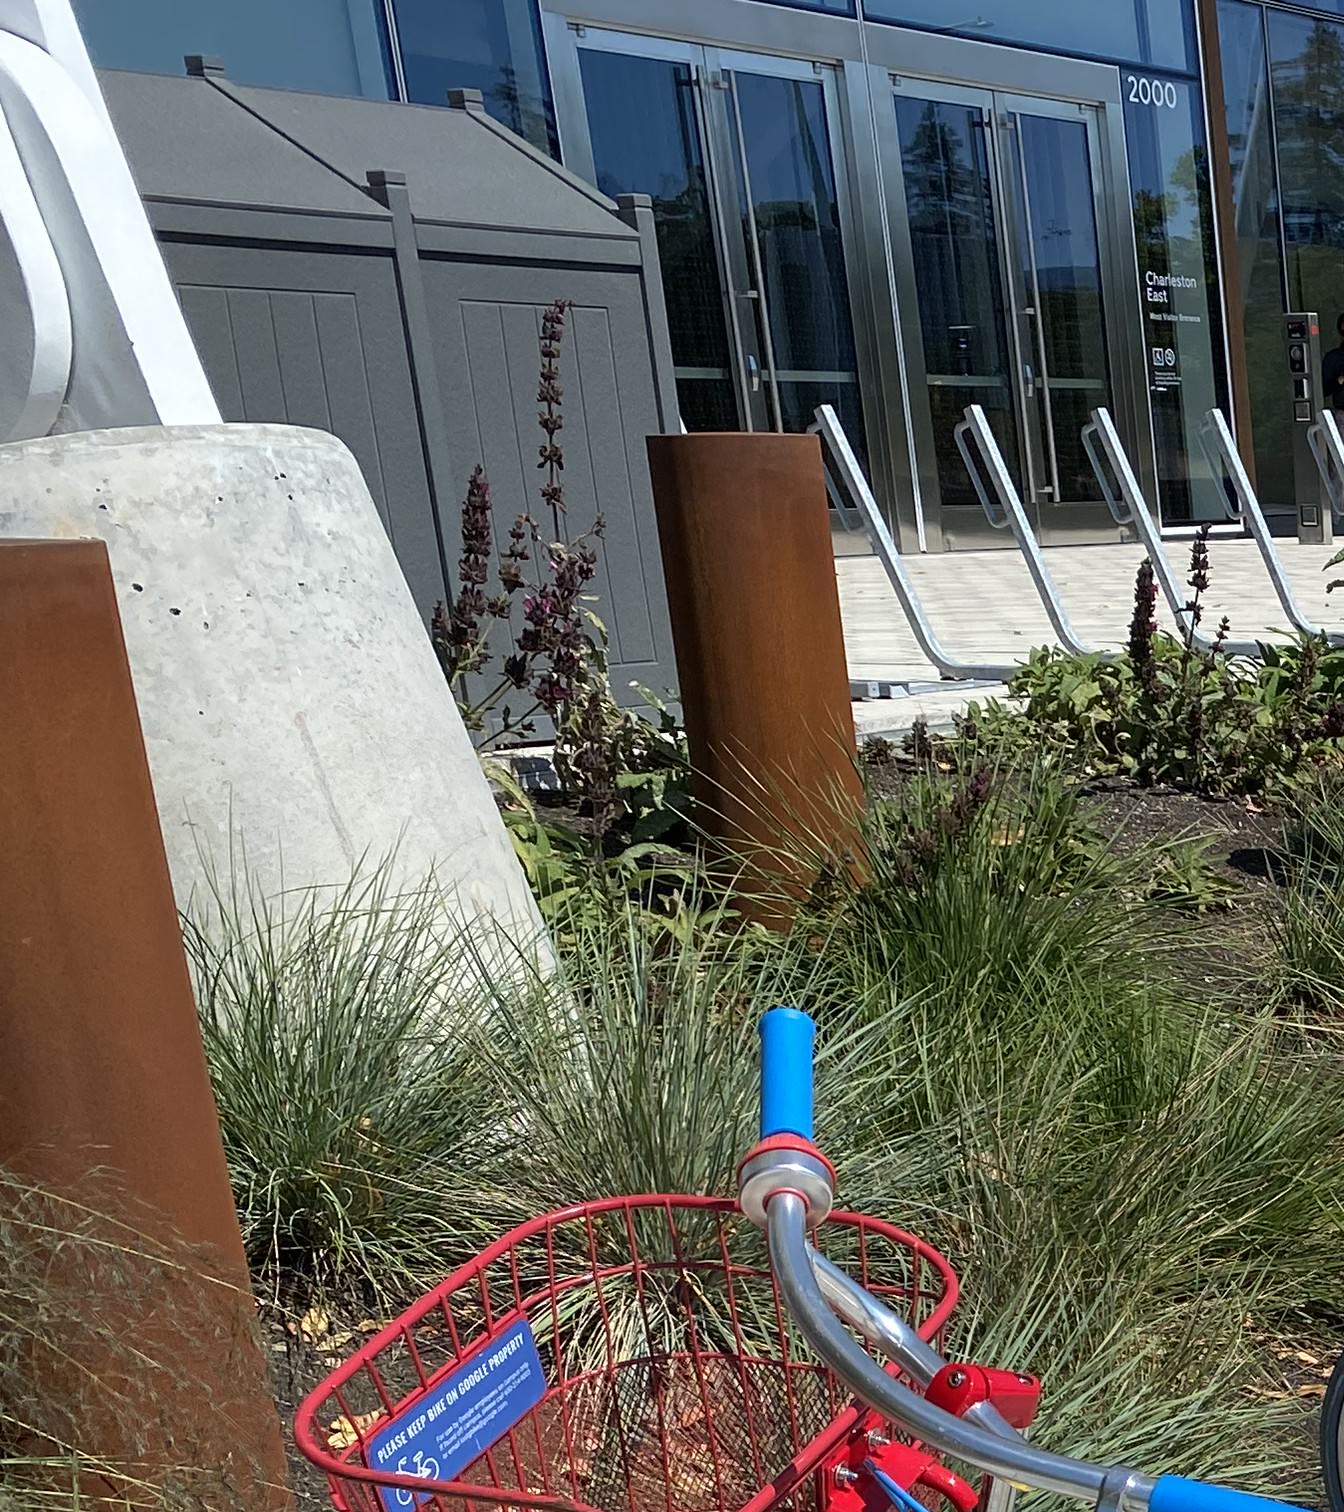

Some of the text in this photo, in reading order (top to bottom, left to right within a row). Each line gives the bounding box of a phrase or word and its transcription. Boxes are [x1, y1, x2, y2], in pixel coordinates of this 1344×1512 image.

[1127, 75, 1177, 109] 2000
[1145, 270, 1197, 289] Charleston
[1146, 287, 1168, 303] East
[377, 1431, 408, 1464] PLEASE
[406, 1414, 427, 1439] KEEP
[426, 1398, 447, 1422] BIKE
[445, 1387, 459, 1406] ON
[457, 1362, 489, 1395] GOOGLE
[488, 1332, 525, 1371] PROPERTY
